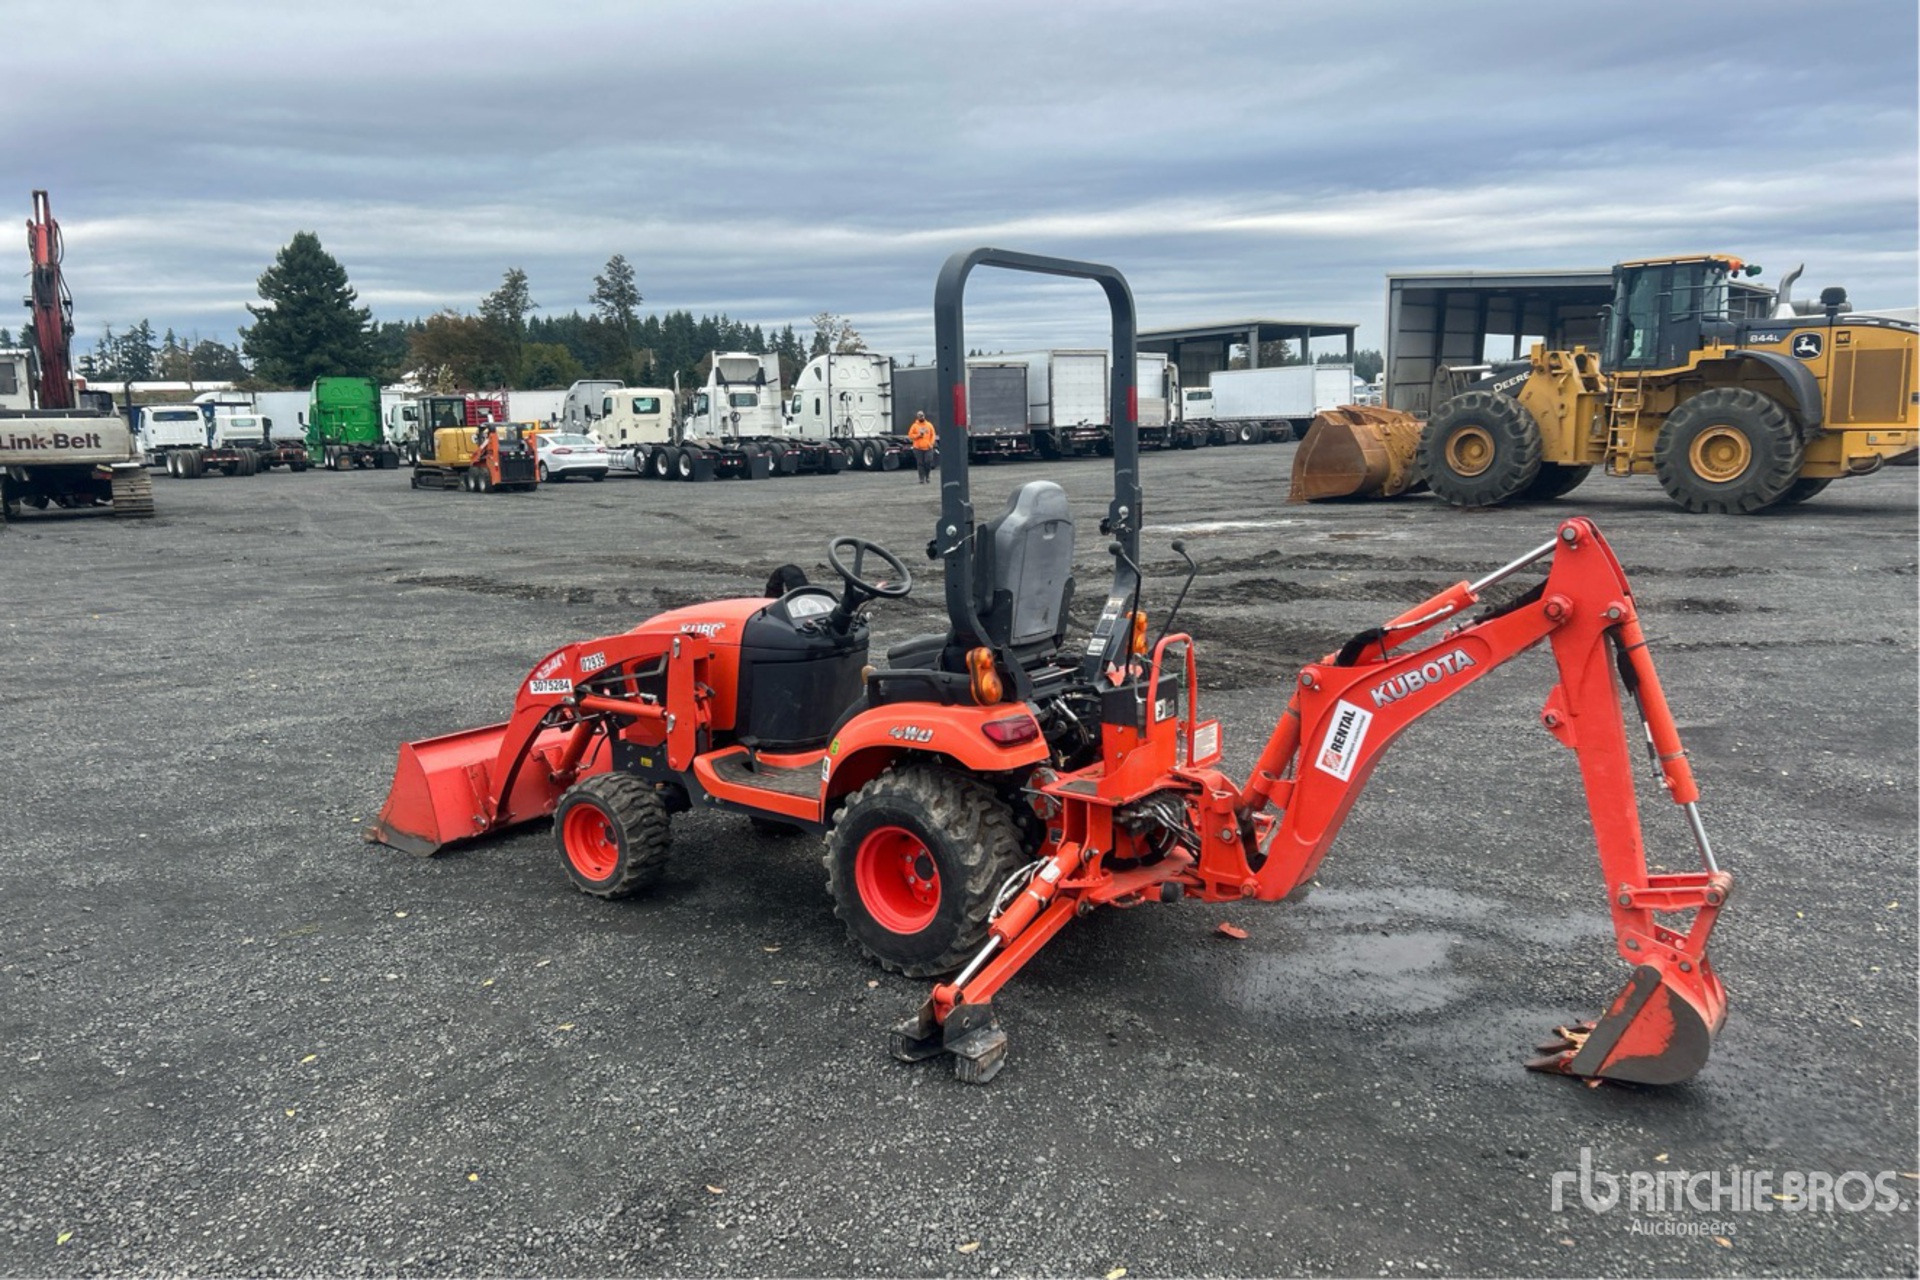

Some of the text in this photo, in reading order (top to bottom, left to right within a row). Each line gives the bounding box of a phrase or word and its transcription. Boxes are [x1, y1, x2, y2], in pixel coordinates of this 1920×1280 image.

[1750, 334, 1779, 342] 844L
[1493, 371, 1530, 392] DEERE
[0, 432, 102, 449] Link-Belt
[532, 680, 570, 692] 3075284
[1370, 649, 1476, 708] KUBOTA
[1331, 710, 1356, 753] RENTAL
